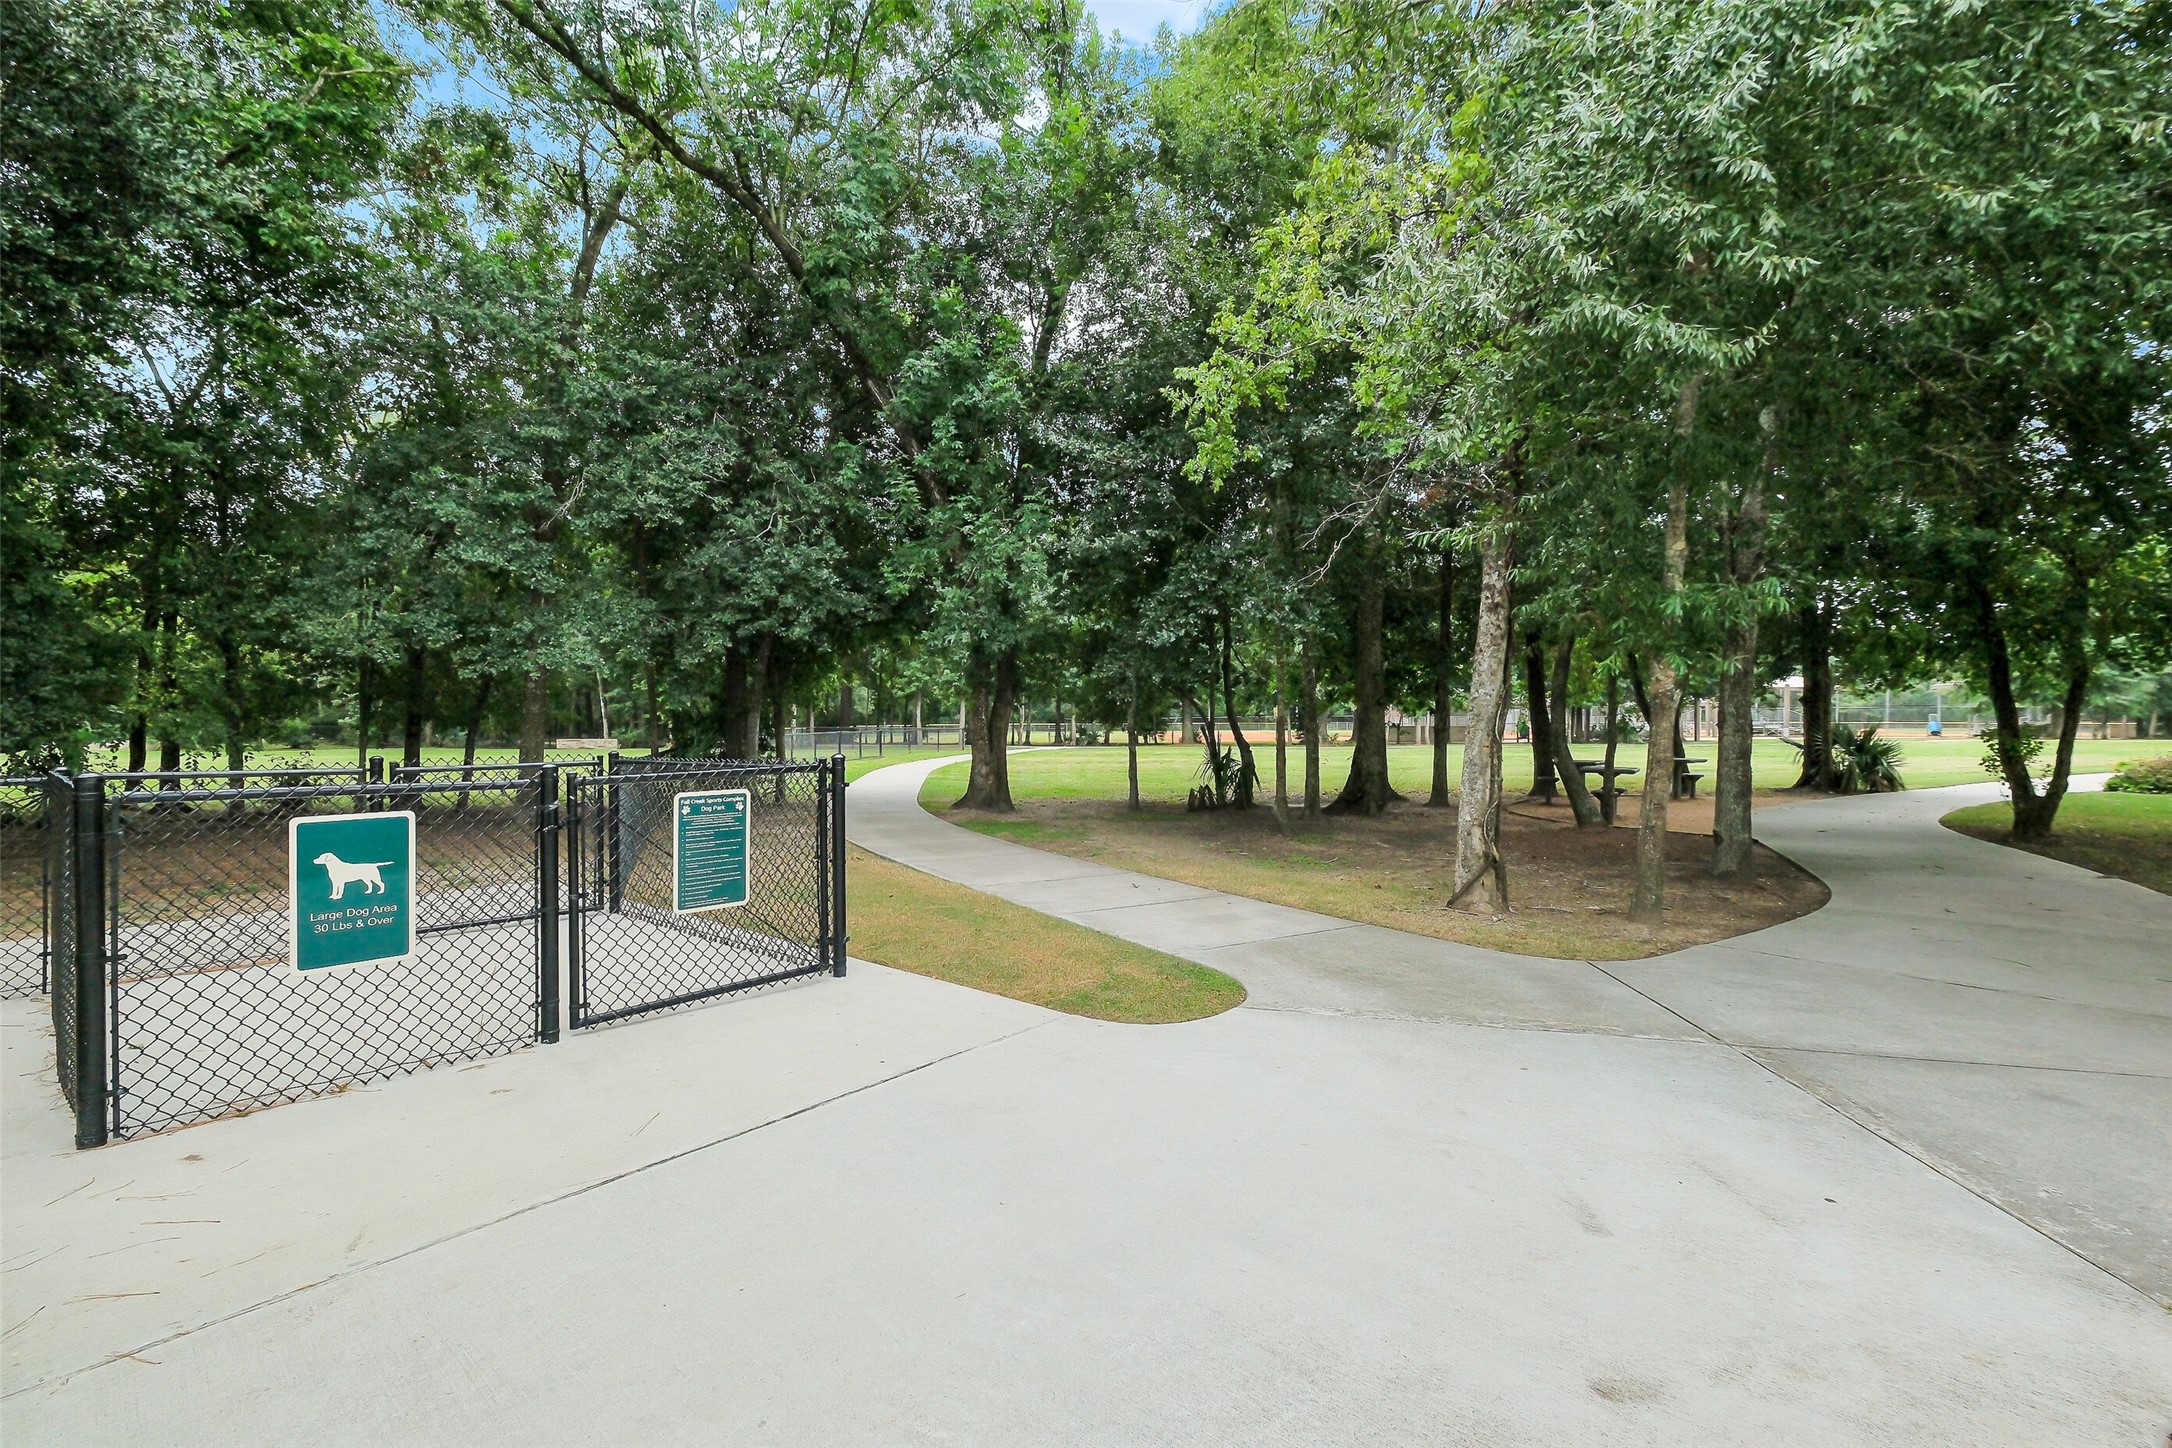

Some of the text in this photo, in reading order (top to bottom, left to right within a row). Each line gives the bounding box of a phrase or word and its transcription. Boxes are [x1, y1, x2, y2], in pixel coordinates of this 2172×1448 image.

[310, 904, 397, 922] Large Dog Area
[314, 916, 394, 934] 30 Lbs & Over
